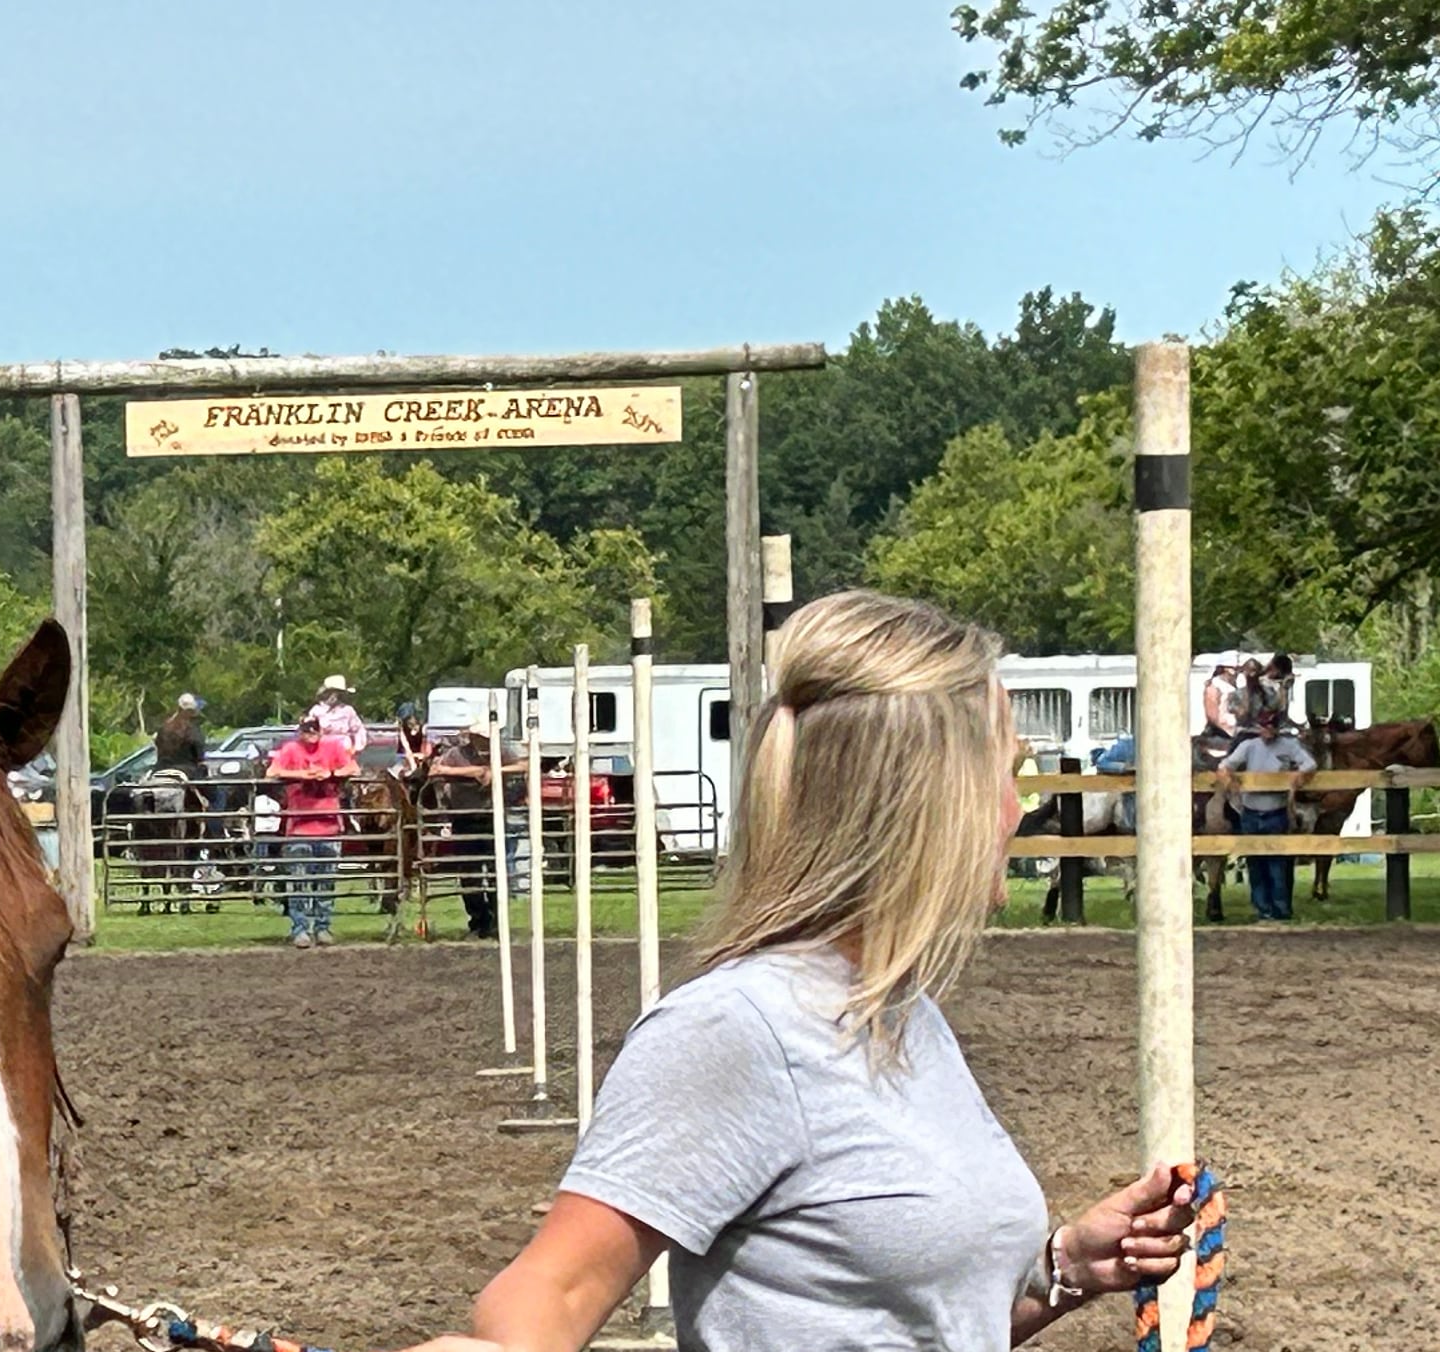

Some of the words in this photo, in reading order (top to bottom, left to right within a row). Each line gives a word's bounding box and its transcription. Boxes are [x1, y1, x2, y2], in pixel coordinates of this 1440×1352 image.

[203, 401, 366, 428] FRANKLIN
[383, 398, 486, 423] CREEK
[501, 395, 604, 420] ARENA
